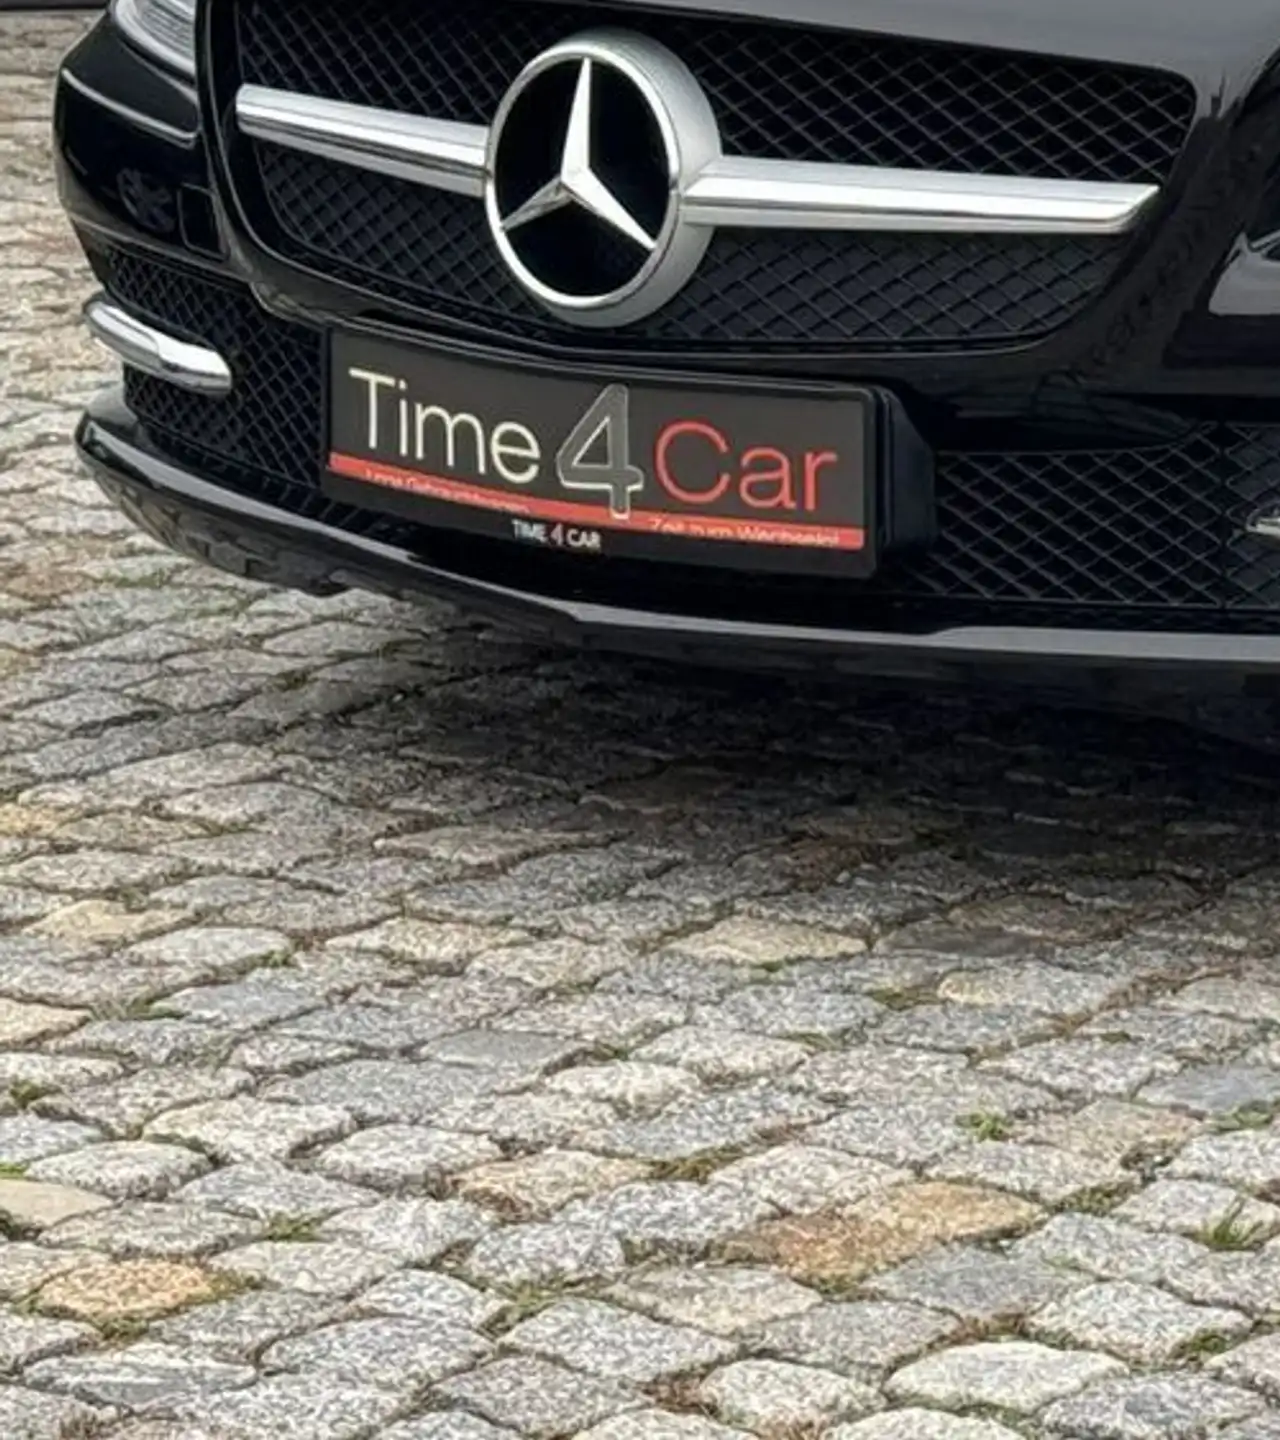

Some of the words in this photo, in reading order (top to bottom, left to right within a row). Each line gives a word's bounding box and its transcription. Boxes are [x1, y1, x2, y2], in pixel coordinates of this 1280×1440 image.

[348, 367, 542, 484] Time
[554, 382, 646, 520] 4
[652, 418, 840, 512] Car
[566, 529, 603, 550] CAR
